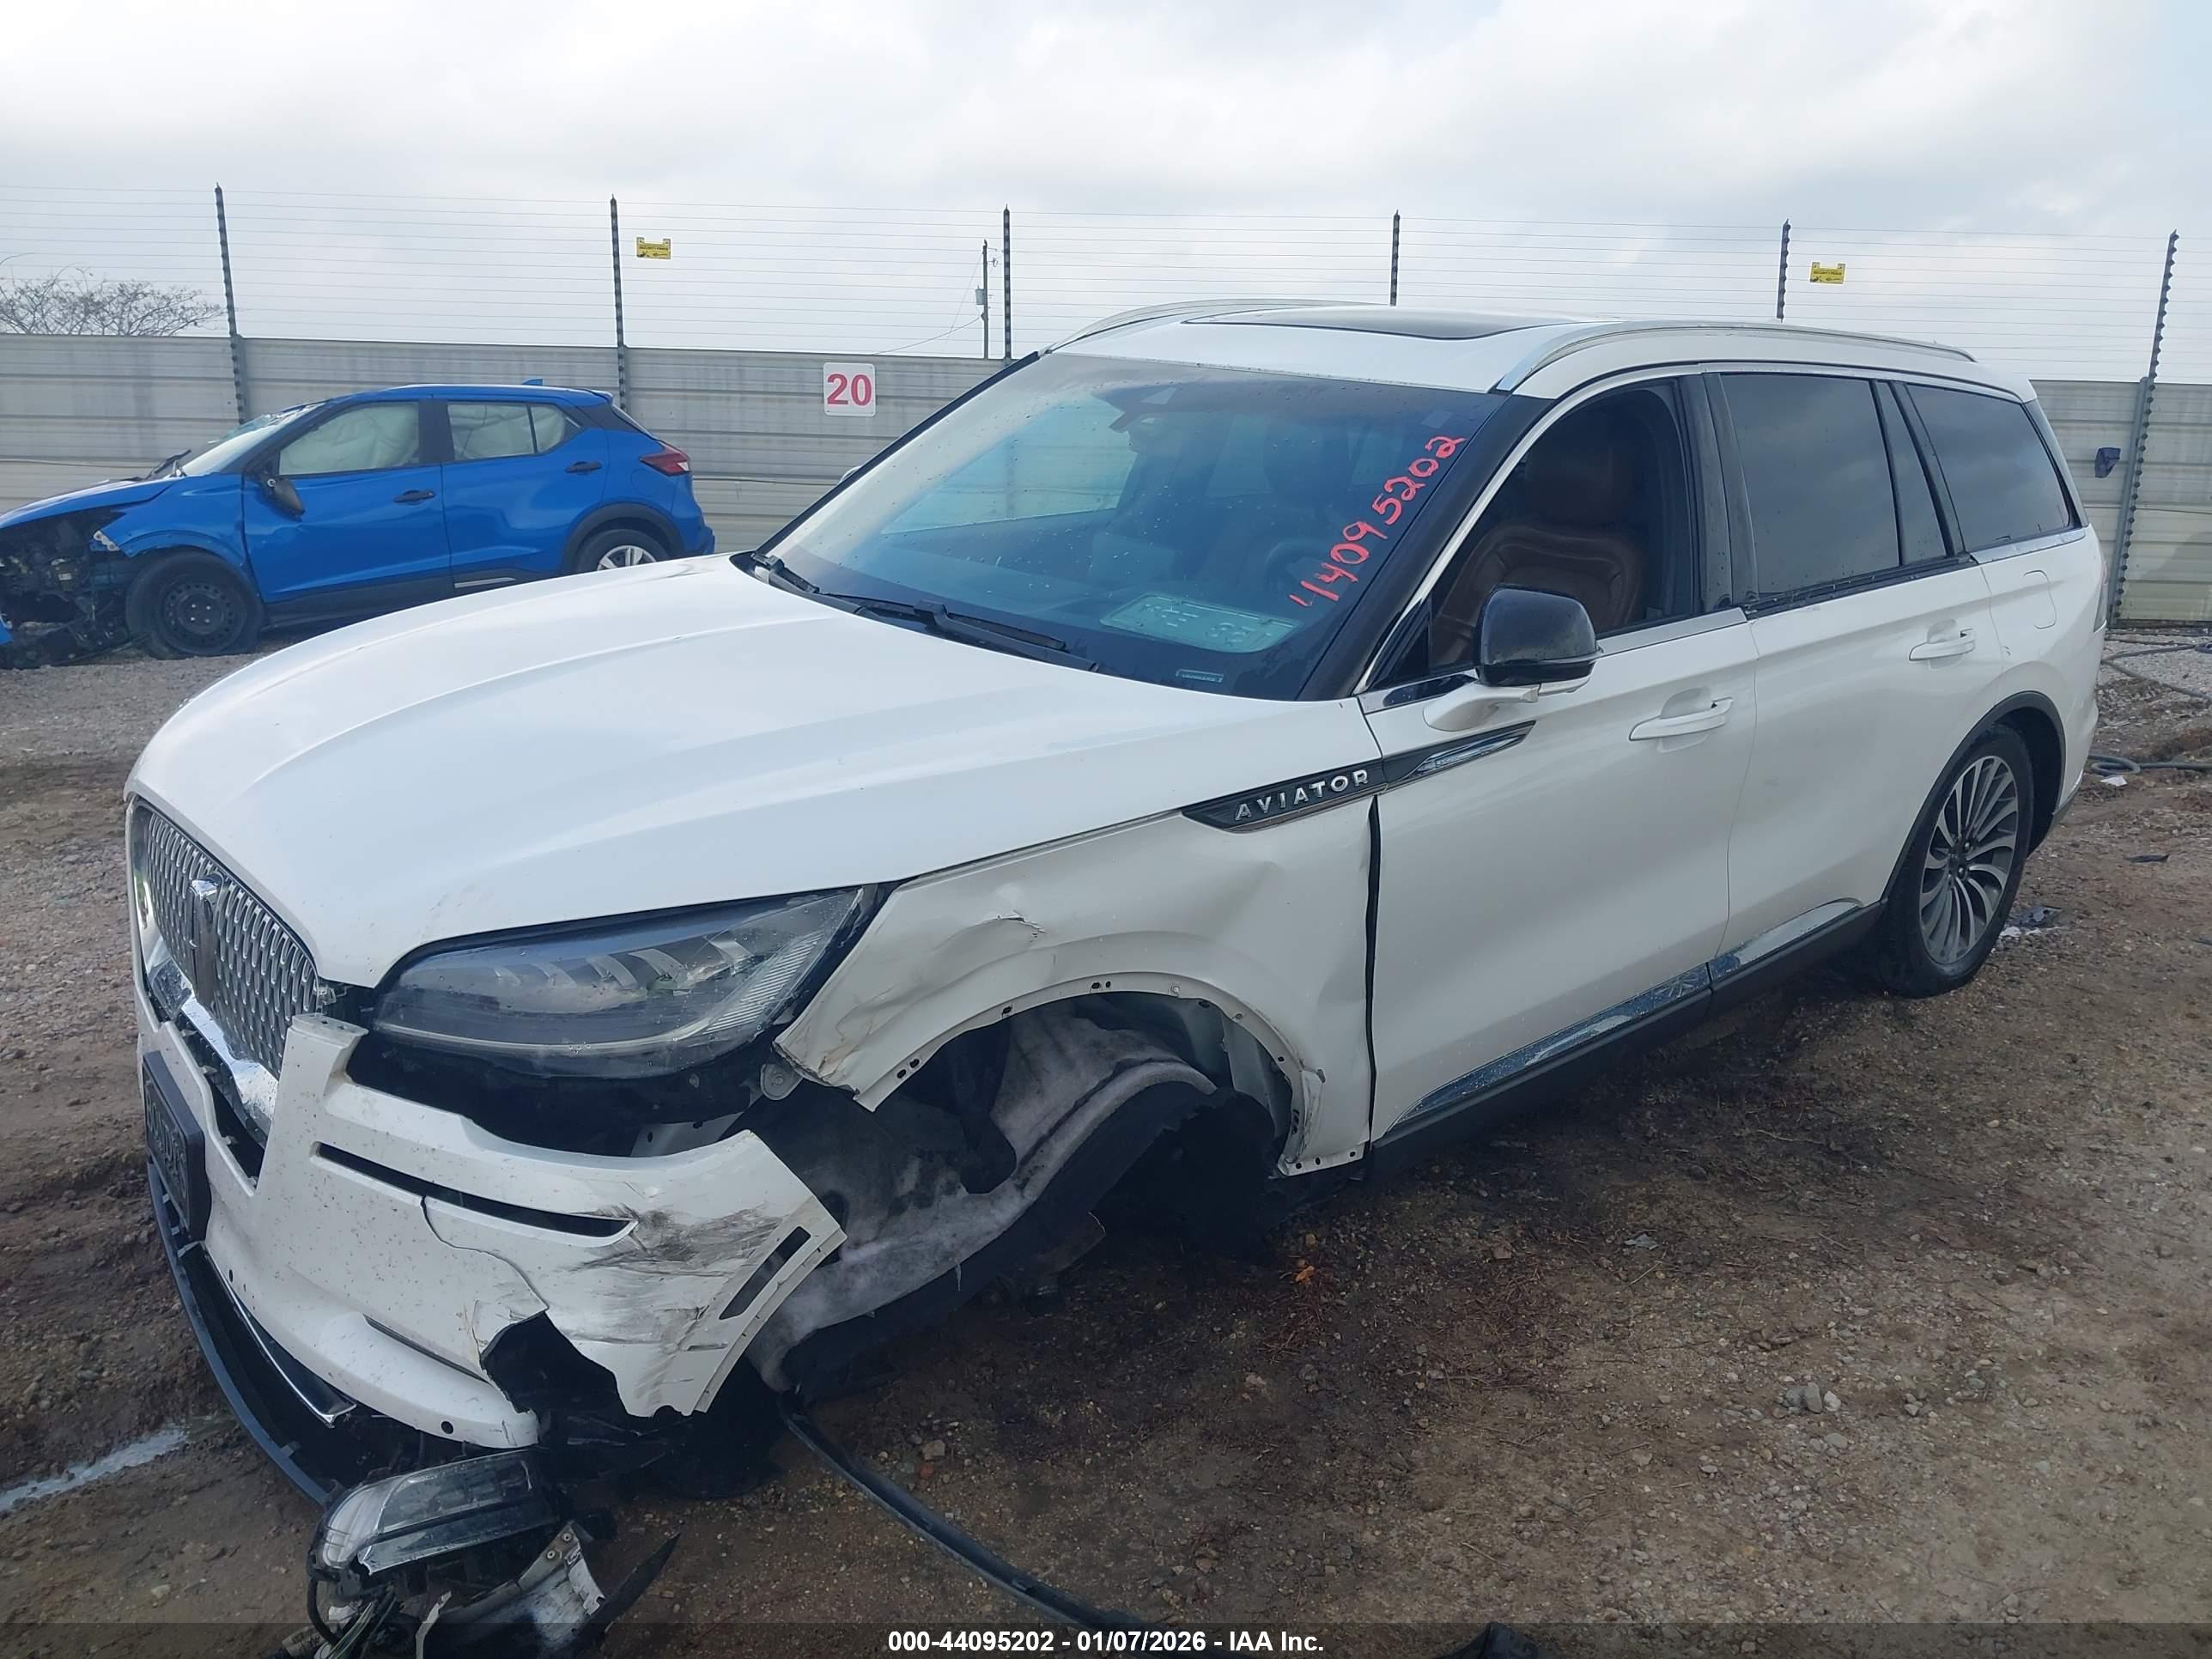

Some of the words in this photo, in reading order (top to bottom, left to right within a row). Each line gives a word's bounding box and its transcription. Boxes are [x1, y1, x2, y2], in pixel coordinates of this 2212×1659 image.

[827, 374, 872, 406] 20
[1290, 436, 1467, 607] 44095202
[1235, 769, 1369, 820] AVIATOR
